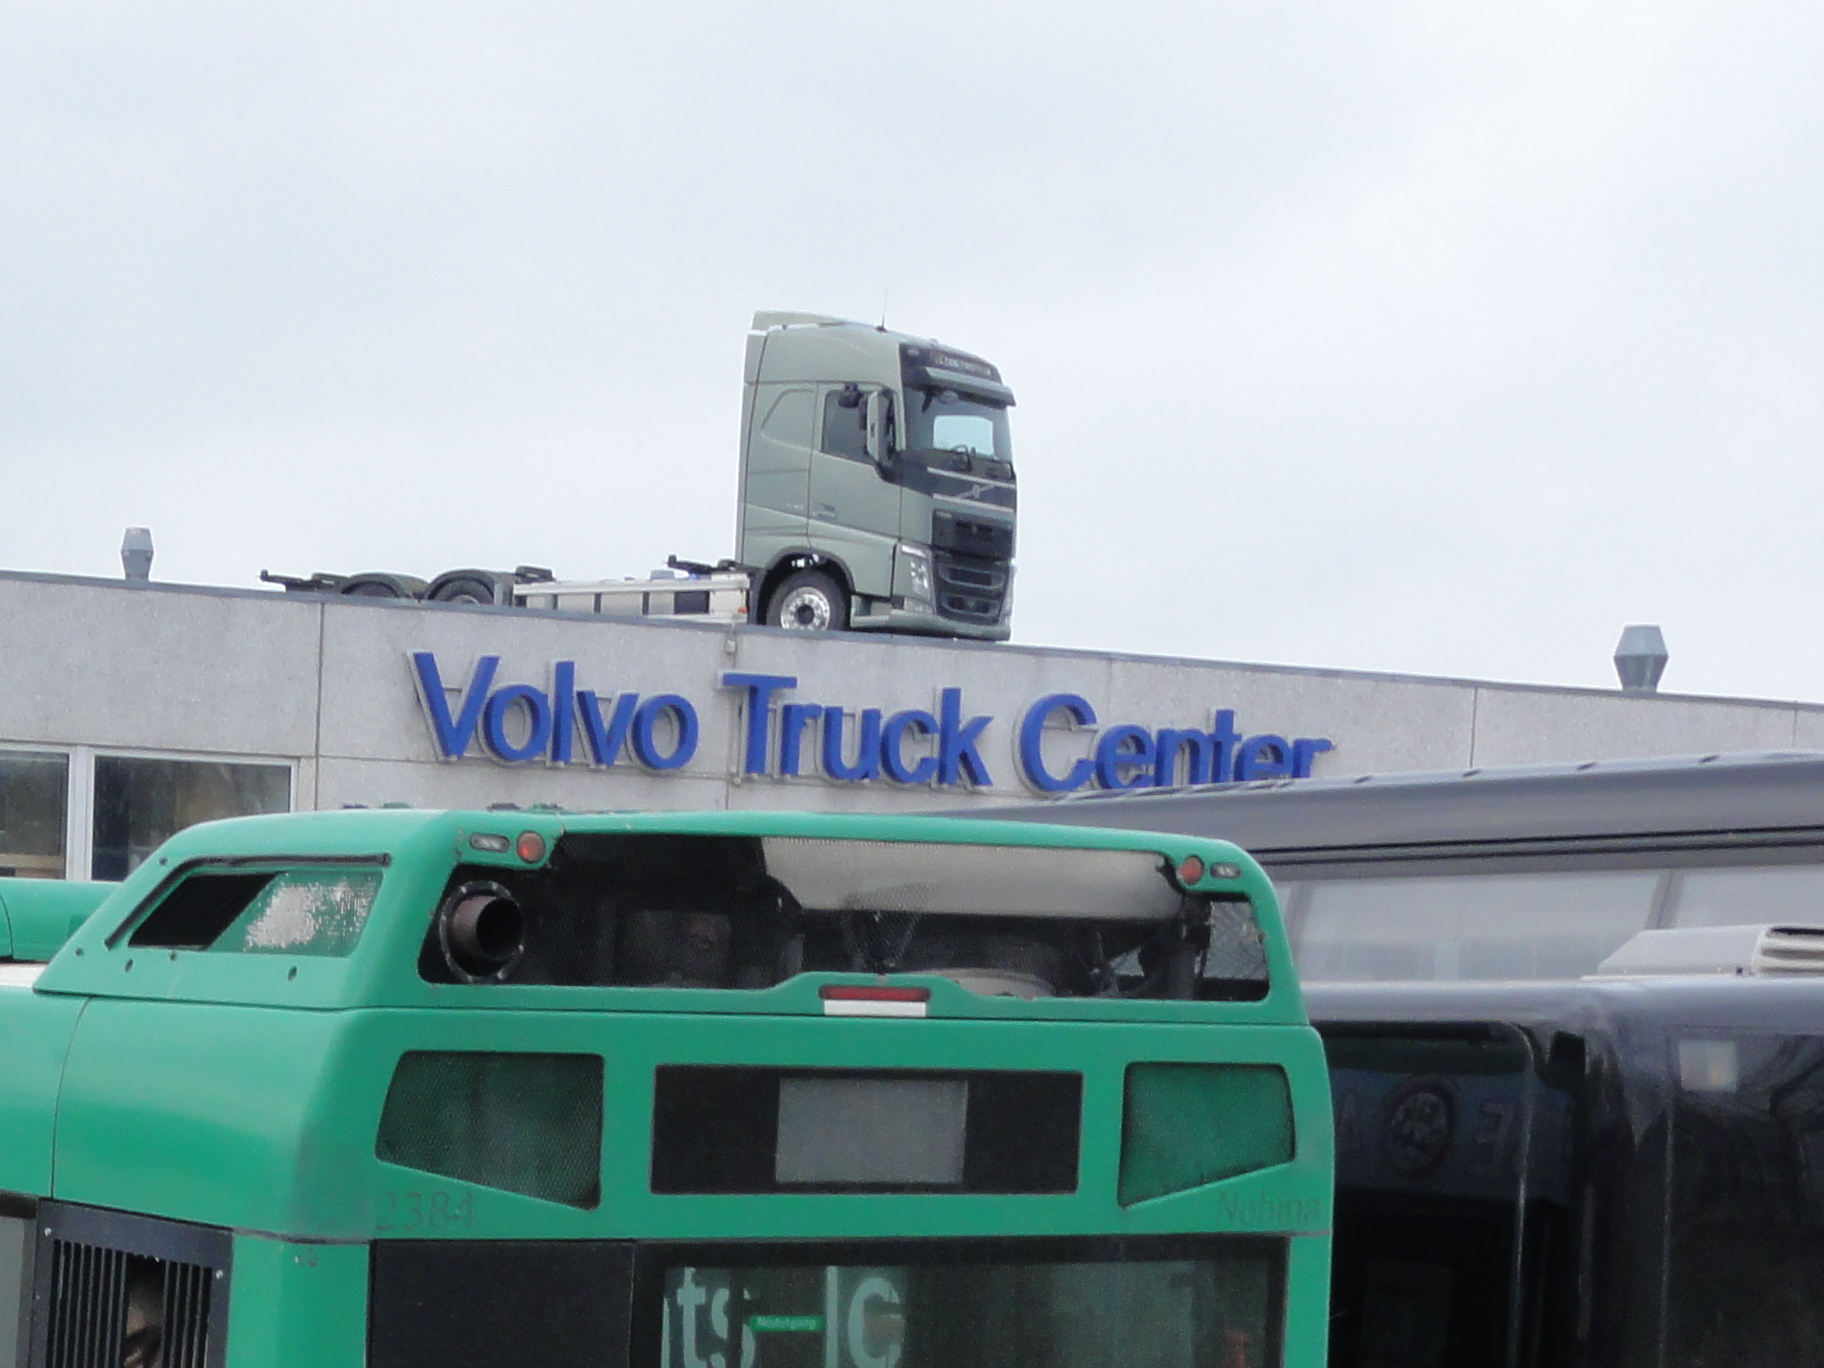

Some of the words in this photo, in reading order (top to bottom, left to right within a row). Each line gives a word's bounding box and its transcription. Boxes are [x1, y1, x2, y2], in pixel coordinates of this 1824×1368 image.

[407, 651, 699, 771] Volvo
[721, 672, 994, 785] Truck
[1018, 693, 1334, 793] Center
